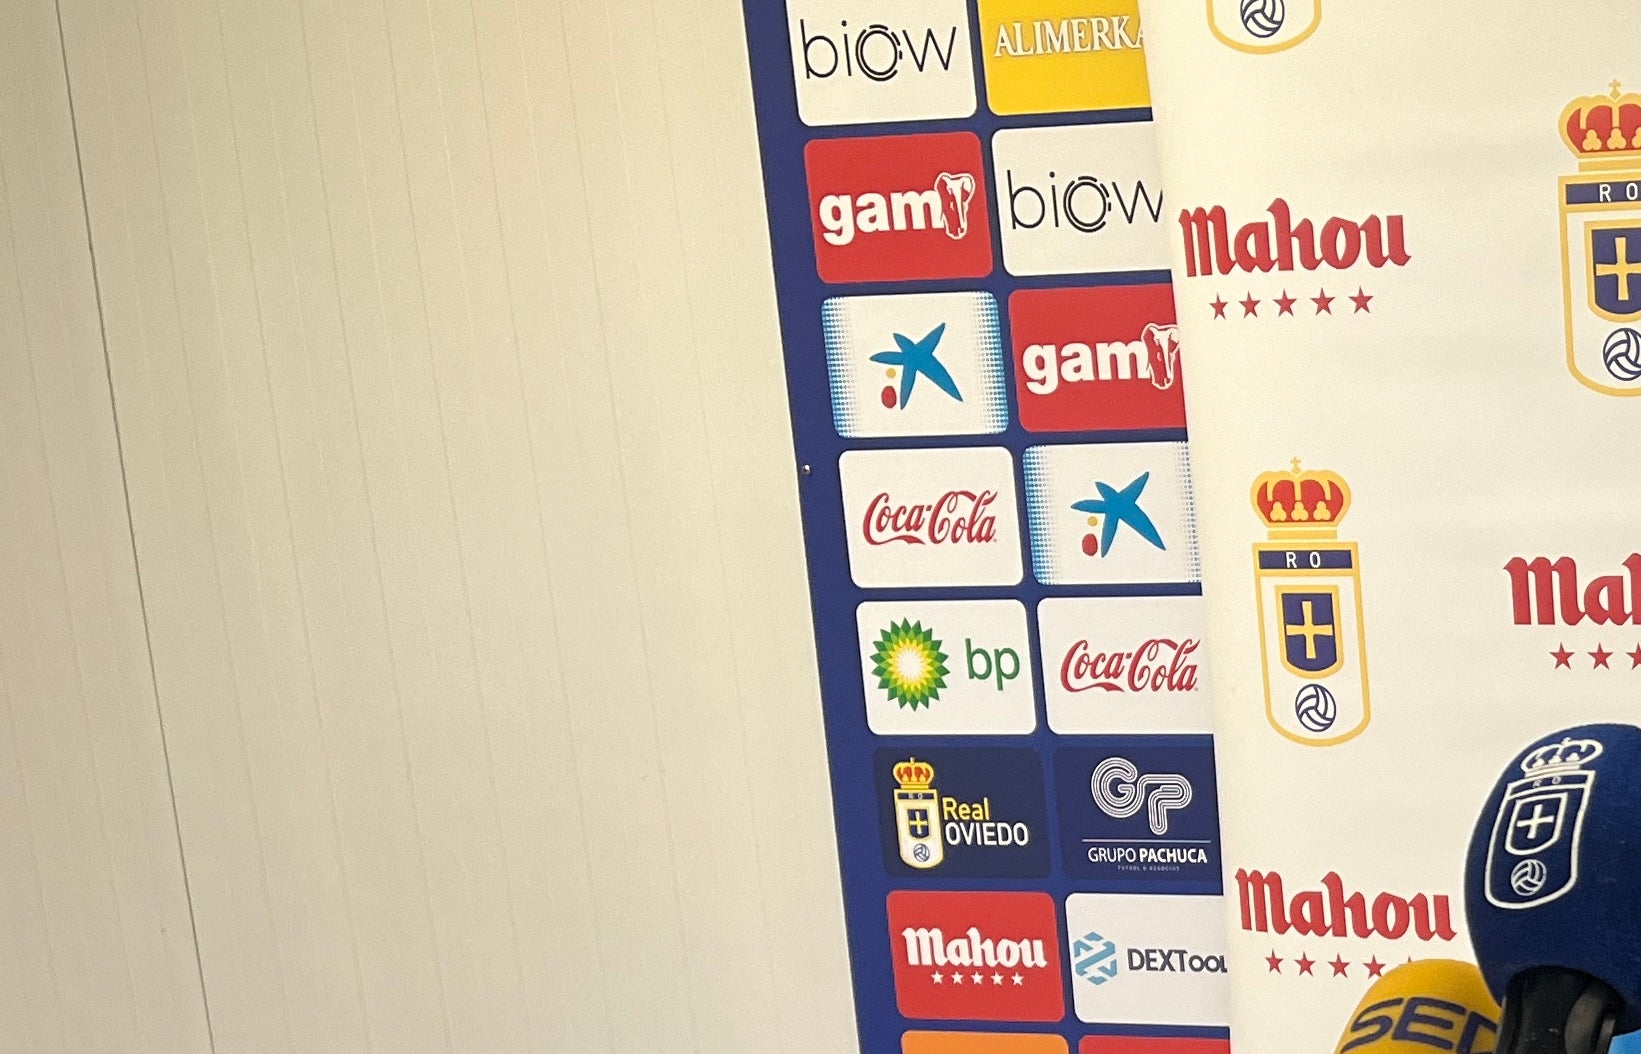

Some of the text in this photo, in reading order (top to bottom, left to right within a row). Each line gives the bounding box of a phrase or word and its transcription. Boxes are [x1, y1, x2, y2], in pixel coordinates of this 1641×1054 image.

[1179, 197, 1412, 277] Mahou
[862, 490, 998, 546] Coca-Cola
[964, 638, 1021, 691] bp
[1060, 638, 1200, 693] Coca-Cola
[942, 797, 990, 821] Real
[945, 822, 1029, 846] OVIEDO
[1087, 847, 1208, 864] GRUPO PACHUCA
[1235, 868, 1457, 942] Mahou
[902, 927, 1048, 969] Mahou
